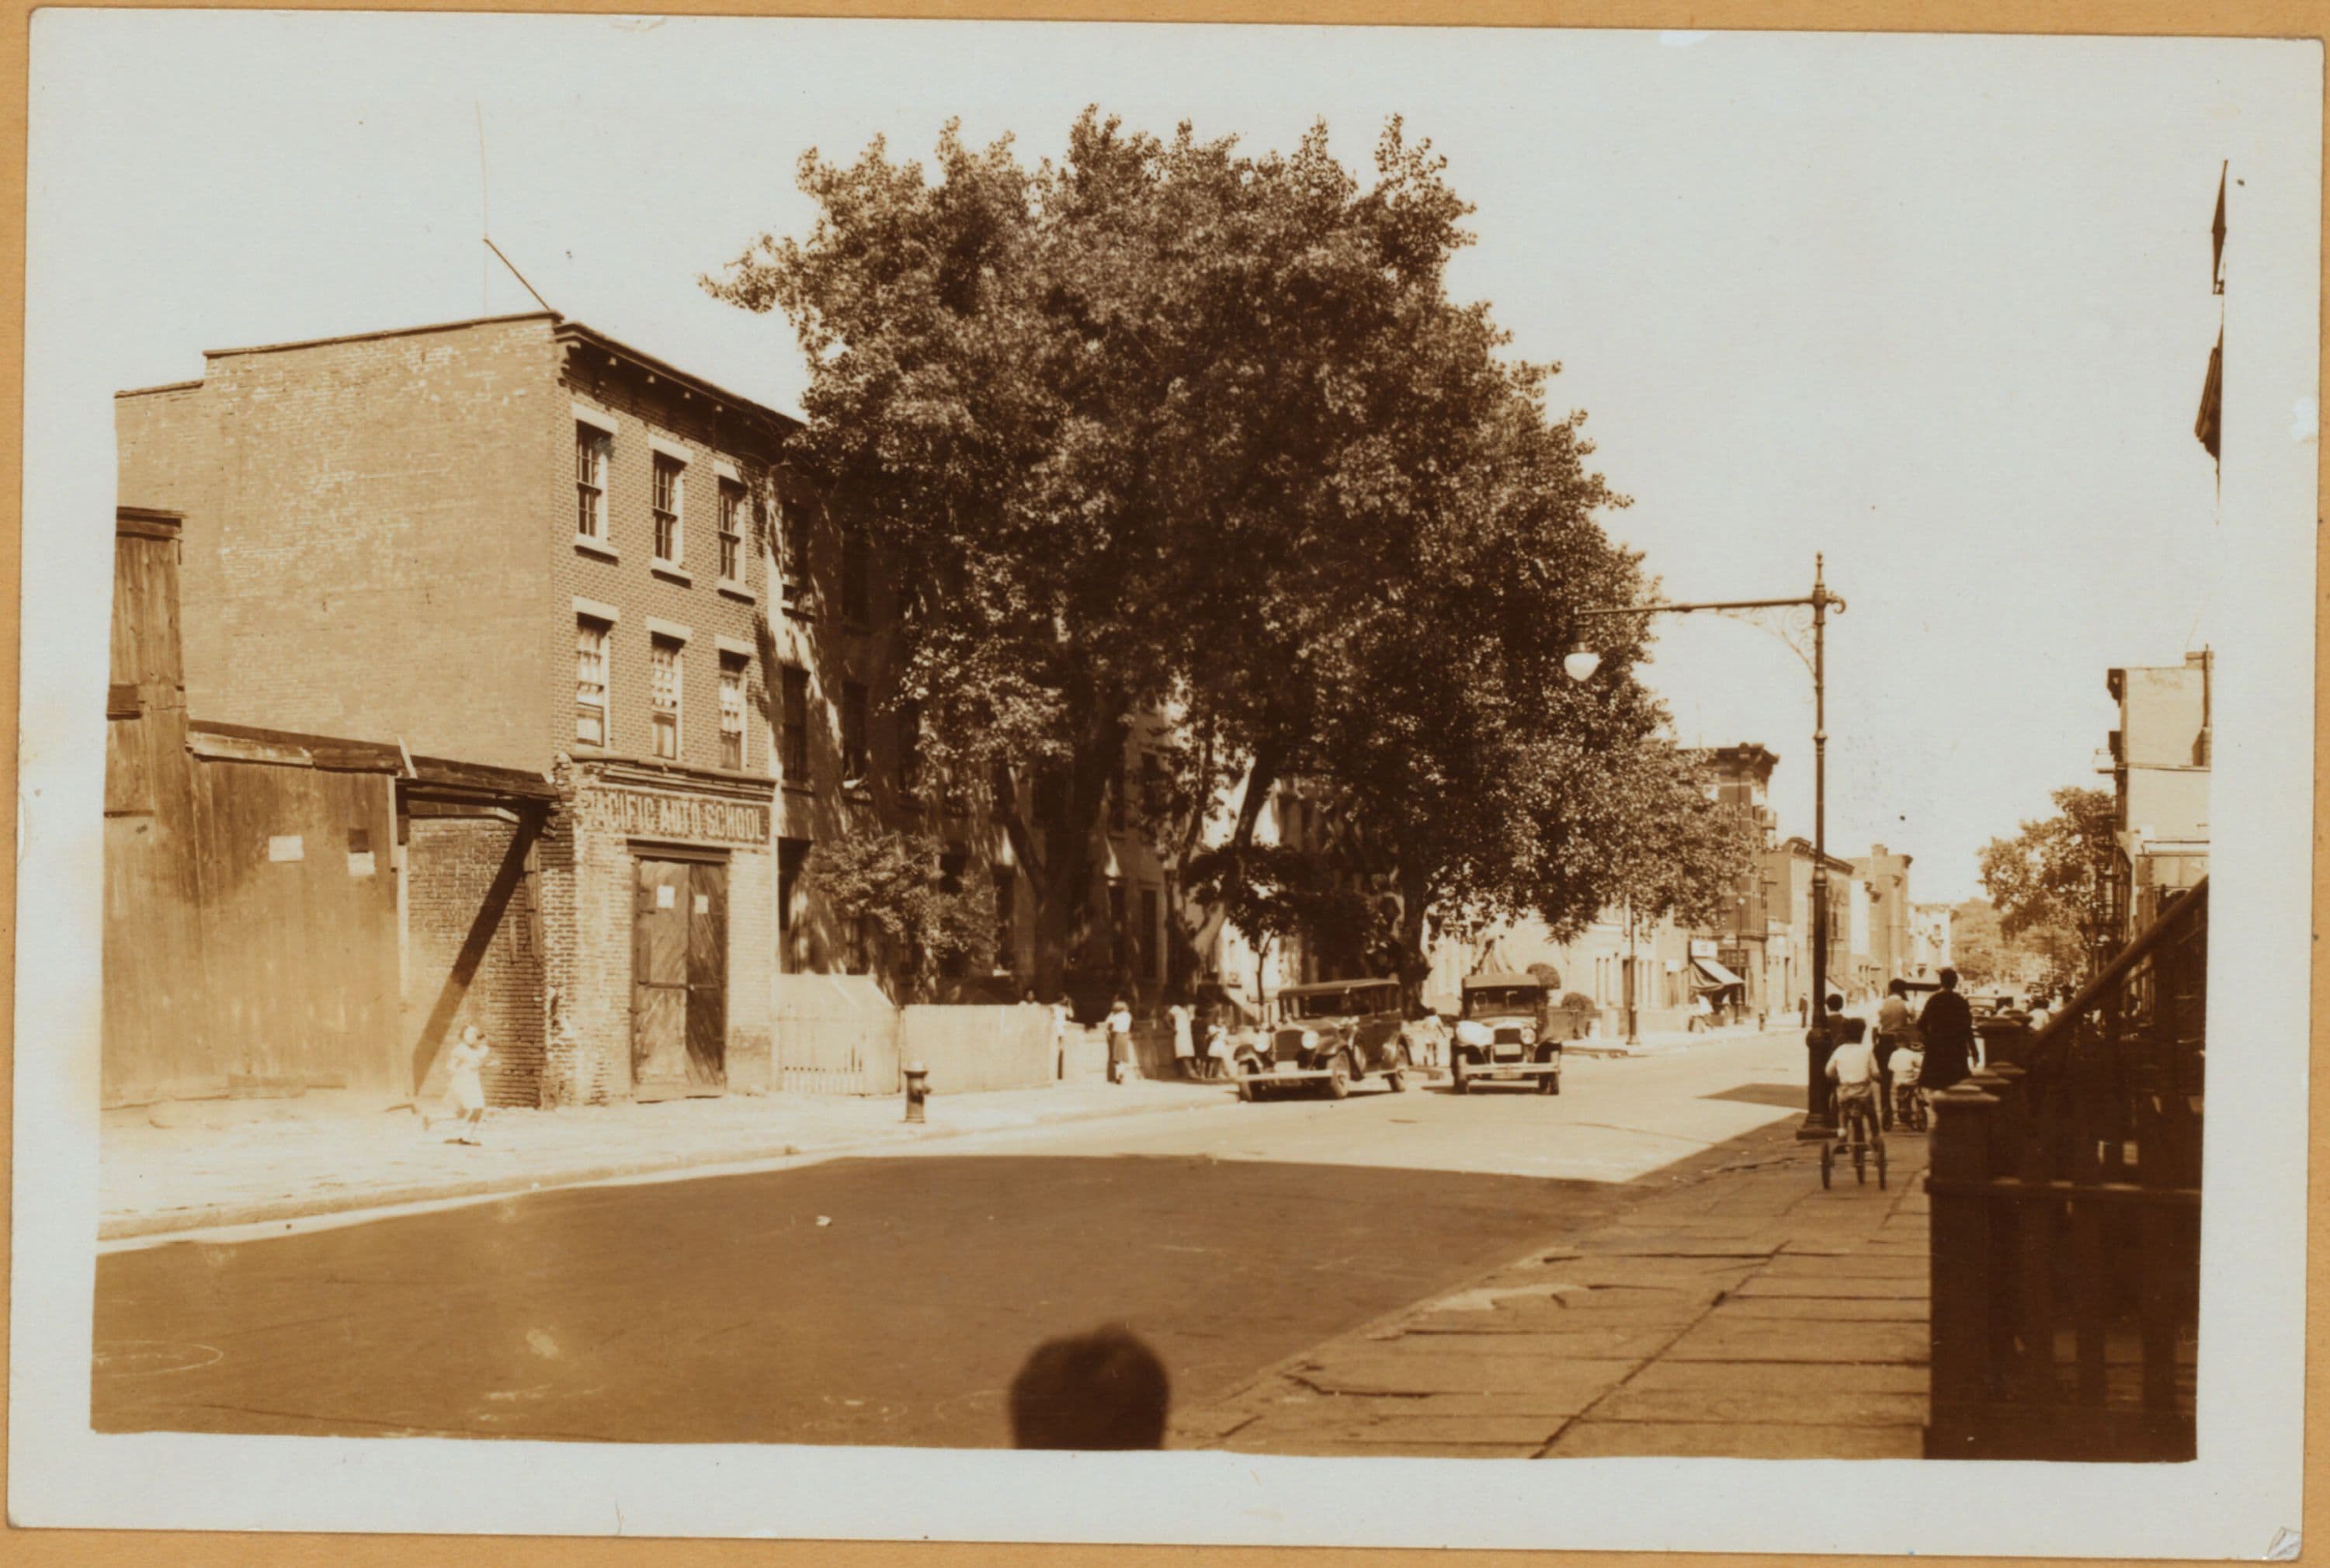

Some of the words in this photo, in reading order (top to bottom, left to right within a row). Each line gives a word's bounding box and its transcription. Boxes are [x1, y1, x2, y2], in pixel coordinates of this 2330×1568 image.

[583, 789, 655, 831] PACIFIC
[659, 799, 700, 834] AUTO
[704, 803, 766, 840] SCHOOL
